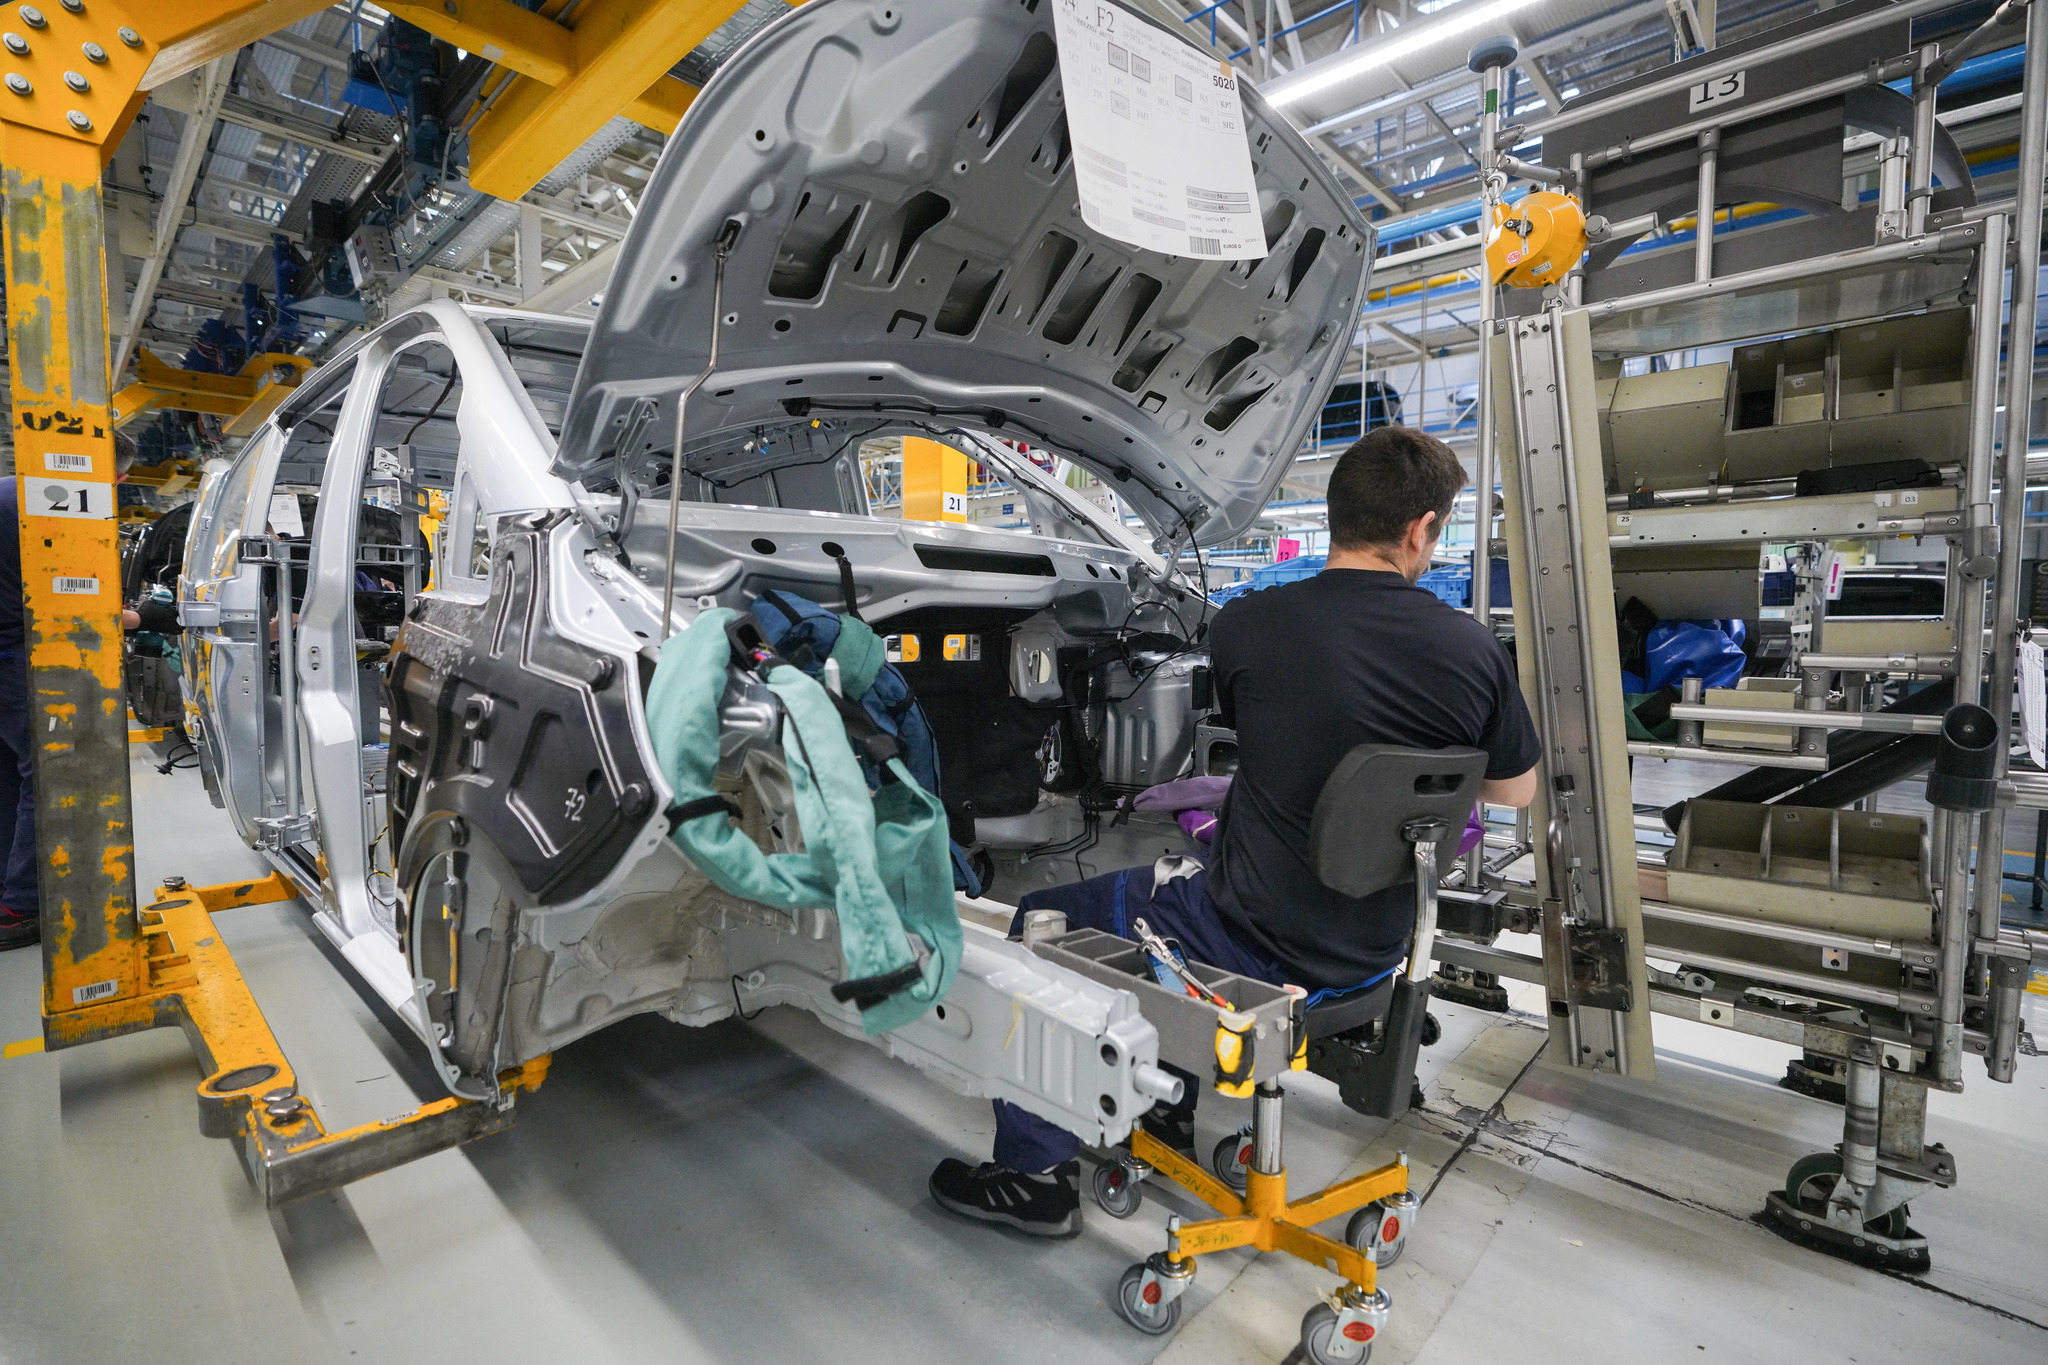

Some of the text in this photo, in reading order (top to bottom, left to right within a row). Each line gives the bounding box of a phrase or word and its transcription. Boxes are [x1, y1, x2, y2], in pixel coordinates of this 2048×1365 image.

[1096, 6, 1115, 34] F2
[1212, 74, 1235, 91] 5020
[1696, 72, 1740, 105] 13
[1222, 120, 1235, 130] SH2
[949, 496, 961, 511] 21
[564, 787, 586, 822] 72
